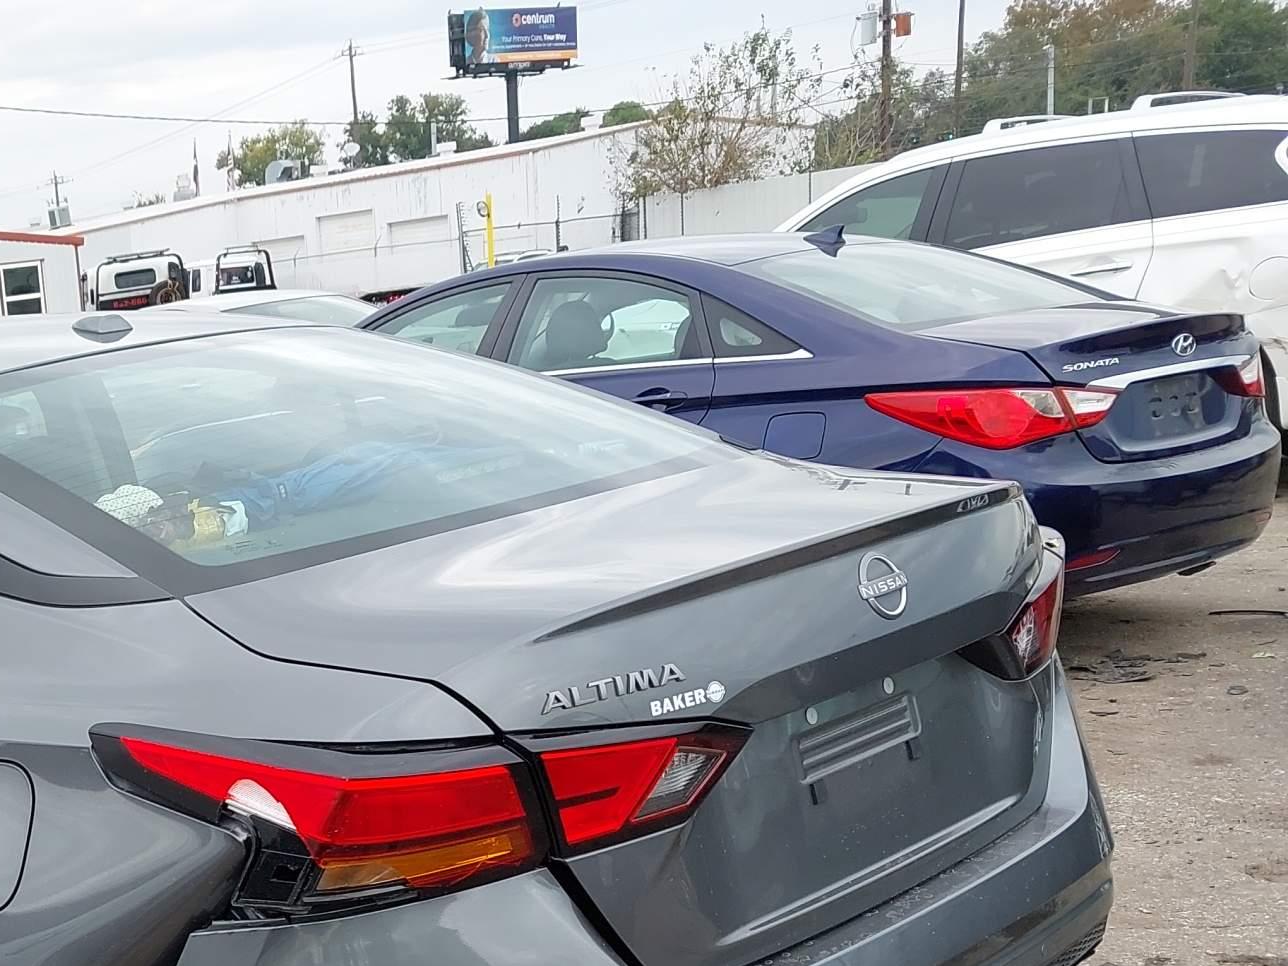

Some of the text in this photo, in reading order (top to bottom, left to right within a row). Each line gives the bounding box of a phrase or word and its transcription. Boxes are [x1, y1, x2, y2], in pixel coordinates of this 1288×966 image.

[521, 13, 555, 24] centrum
[1062, 357, 1120, 373] SONATA
[860, 575, 908, 598] NISSAN
[541, 663, 687, 715] ALTIMA
[650, 688, 707, 717] BAKER
